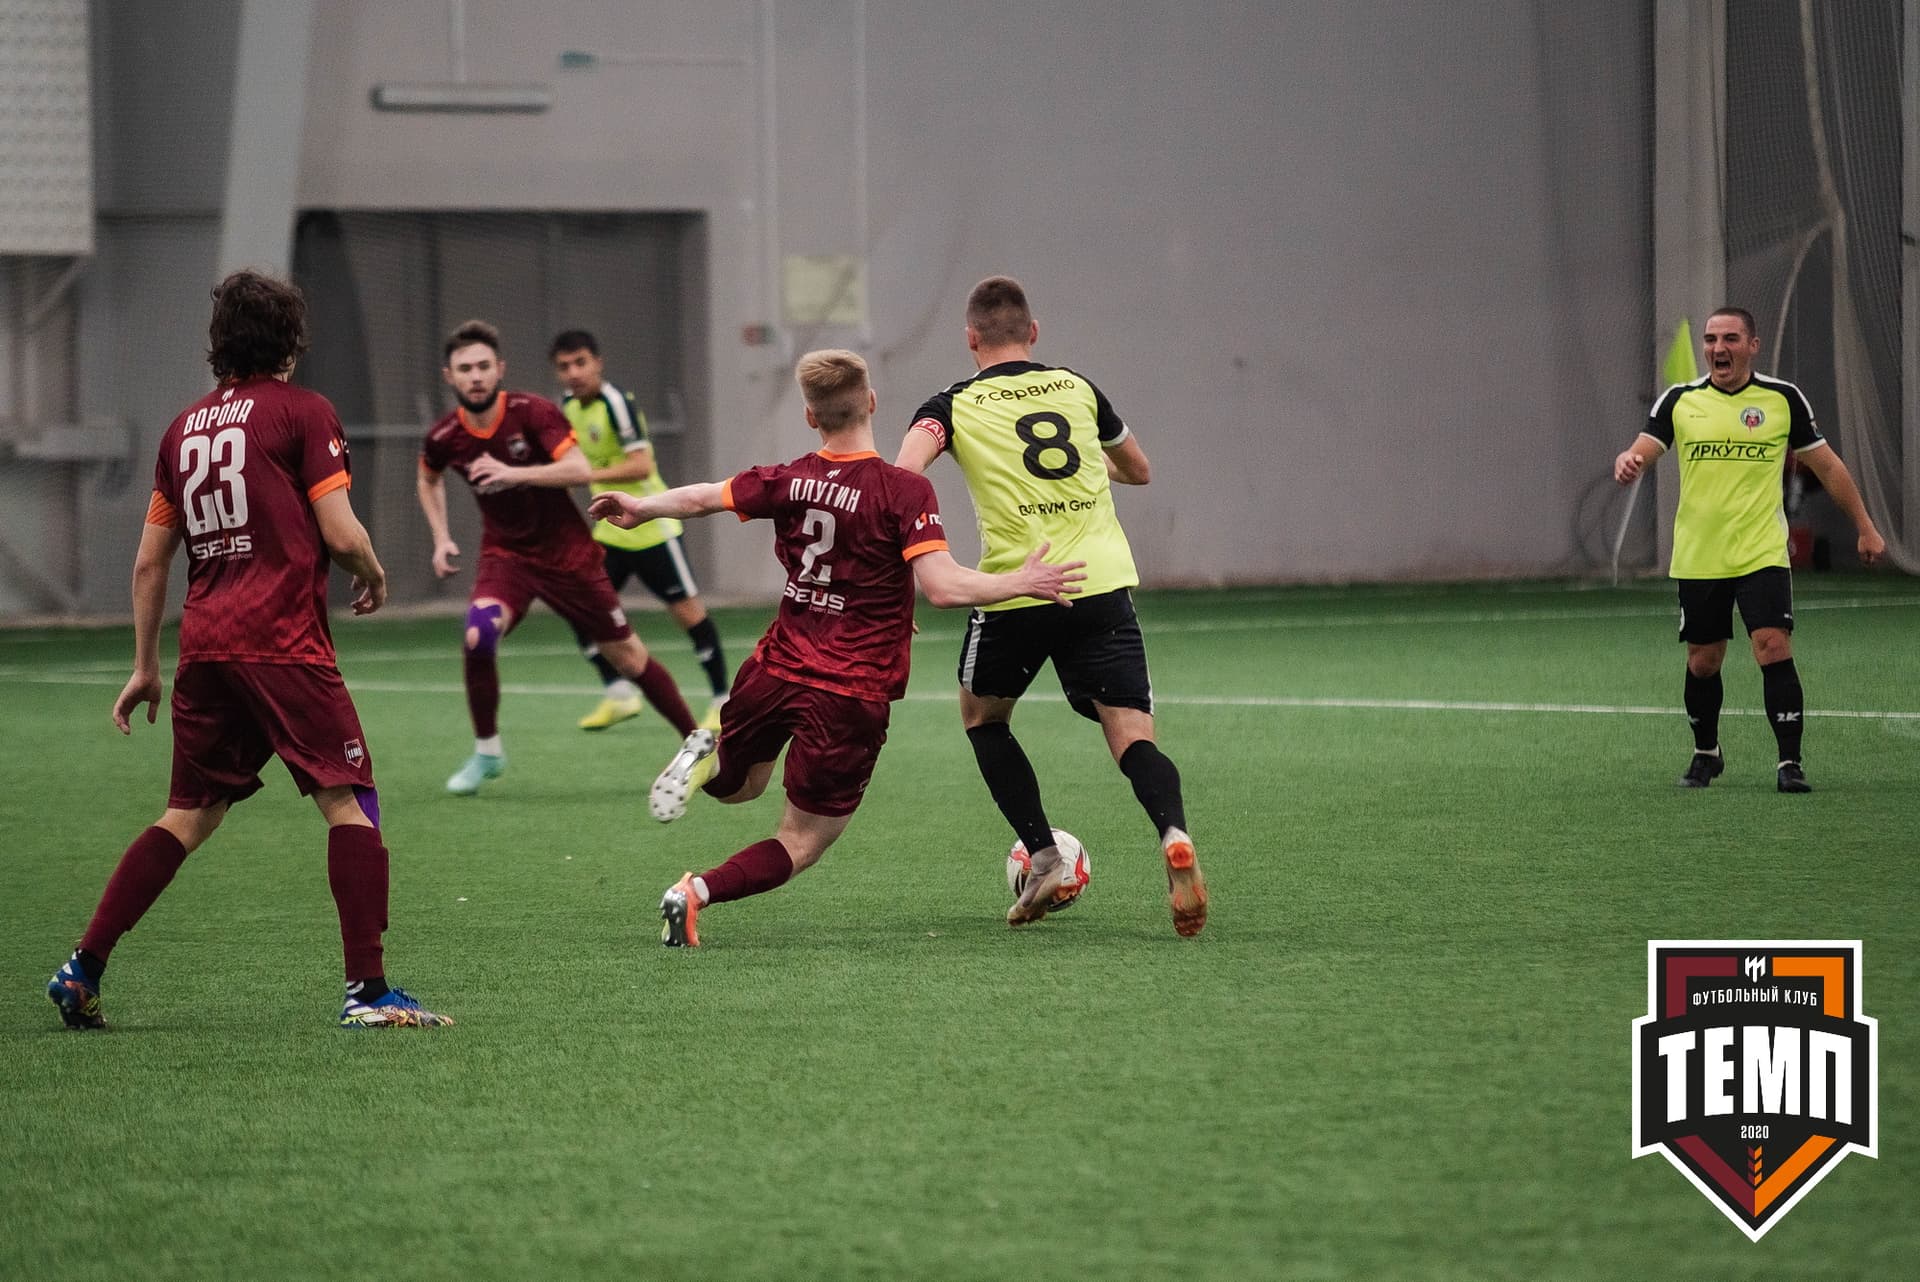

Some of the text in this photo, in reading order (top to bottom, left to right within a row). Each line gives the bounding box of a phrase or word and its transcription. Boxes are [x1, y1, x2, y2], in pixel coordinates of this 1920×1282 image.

[183, 399, 254, 436] ВОРОНА
[1015, 411, 1081, 480] 8
[1690, 443, 1768, 460] ИРКУТСК
[179, 427, 249, 537] 23
[789, 478, 861, 513] ПЛУГИН
[1038, 501, 1066, 515] RVM
[192, 535, 252, 560] SEUS
[797, 508, 836, 587] 2
[784, 582, 846, 611] SEUS
